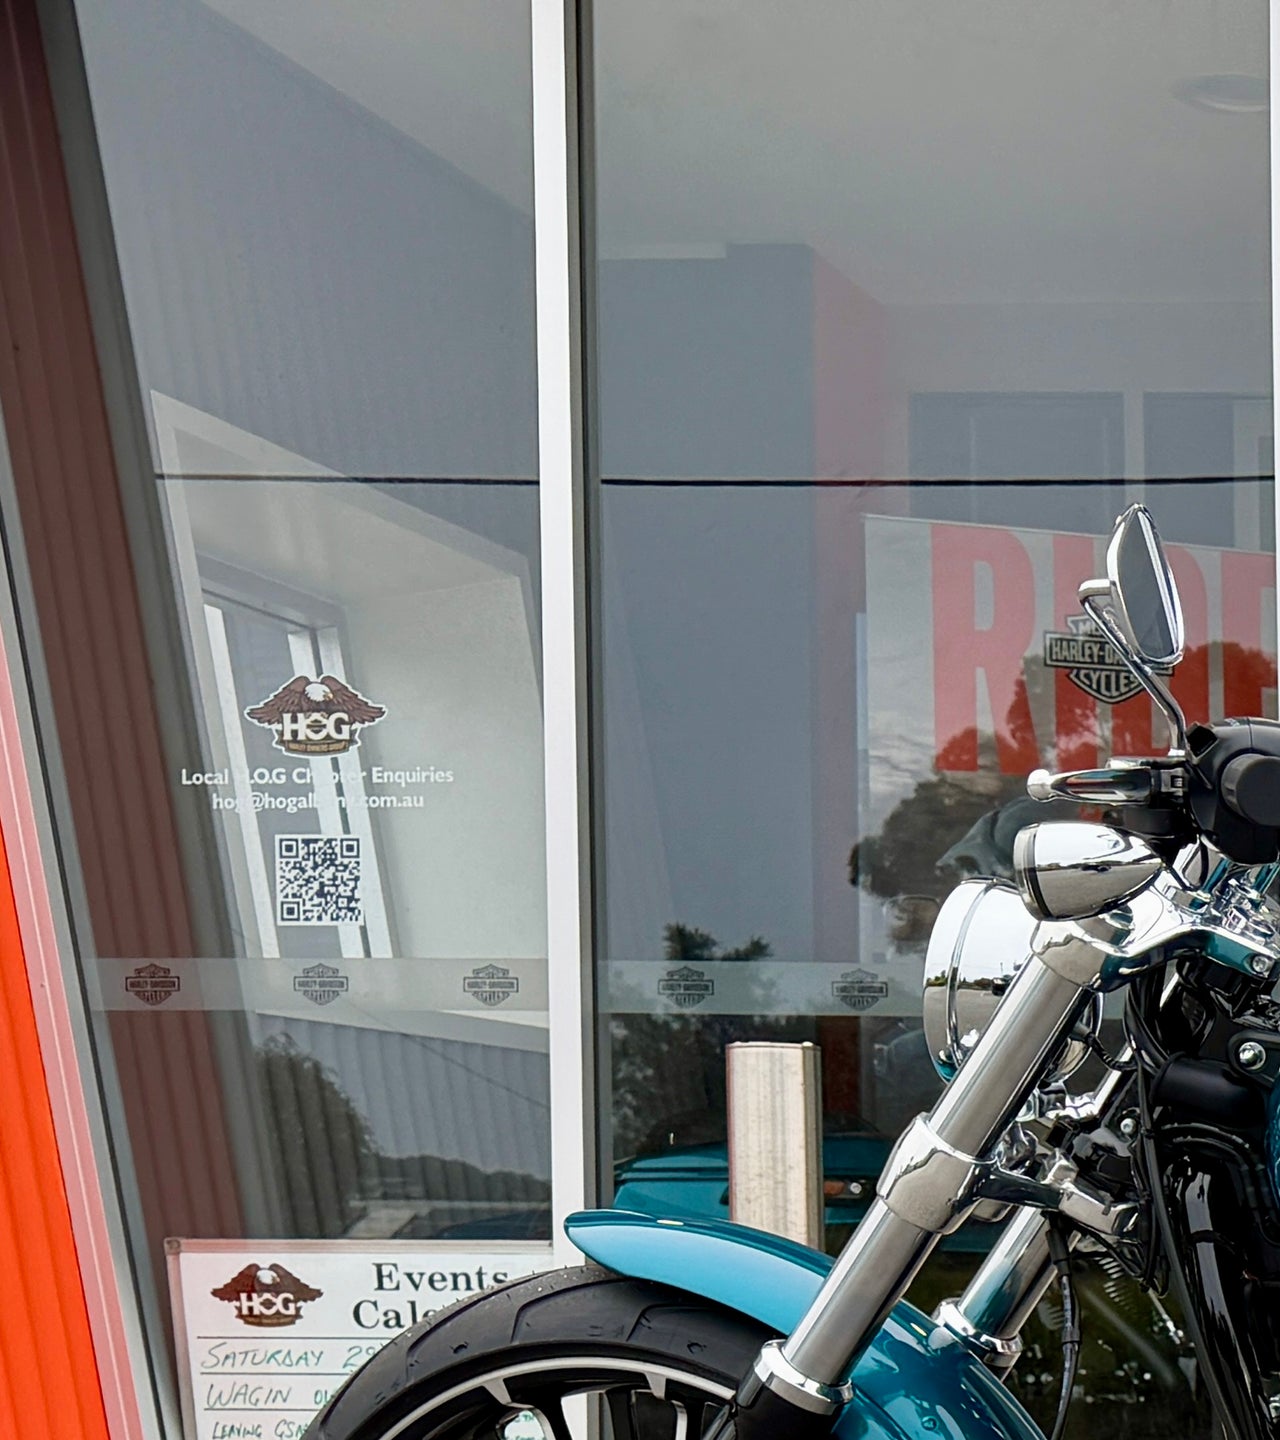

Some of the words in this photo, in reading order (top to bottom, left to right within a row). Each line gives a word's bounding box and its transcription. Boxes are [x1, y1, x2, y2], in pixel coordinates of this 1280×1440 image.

[282, 712, 351, 741] HOG
[181, 768, 229, 785] Local
[234, 768, 286, 784] .O.G
[371, 766, 454, 788] Enquiries
[371, 1262, 509, 1292] Events
[241, 1293, 296, 1316] HOG
[201, 1342, 323, 1369] SATURDAY
